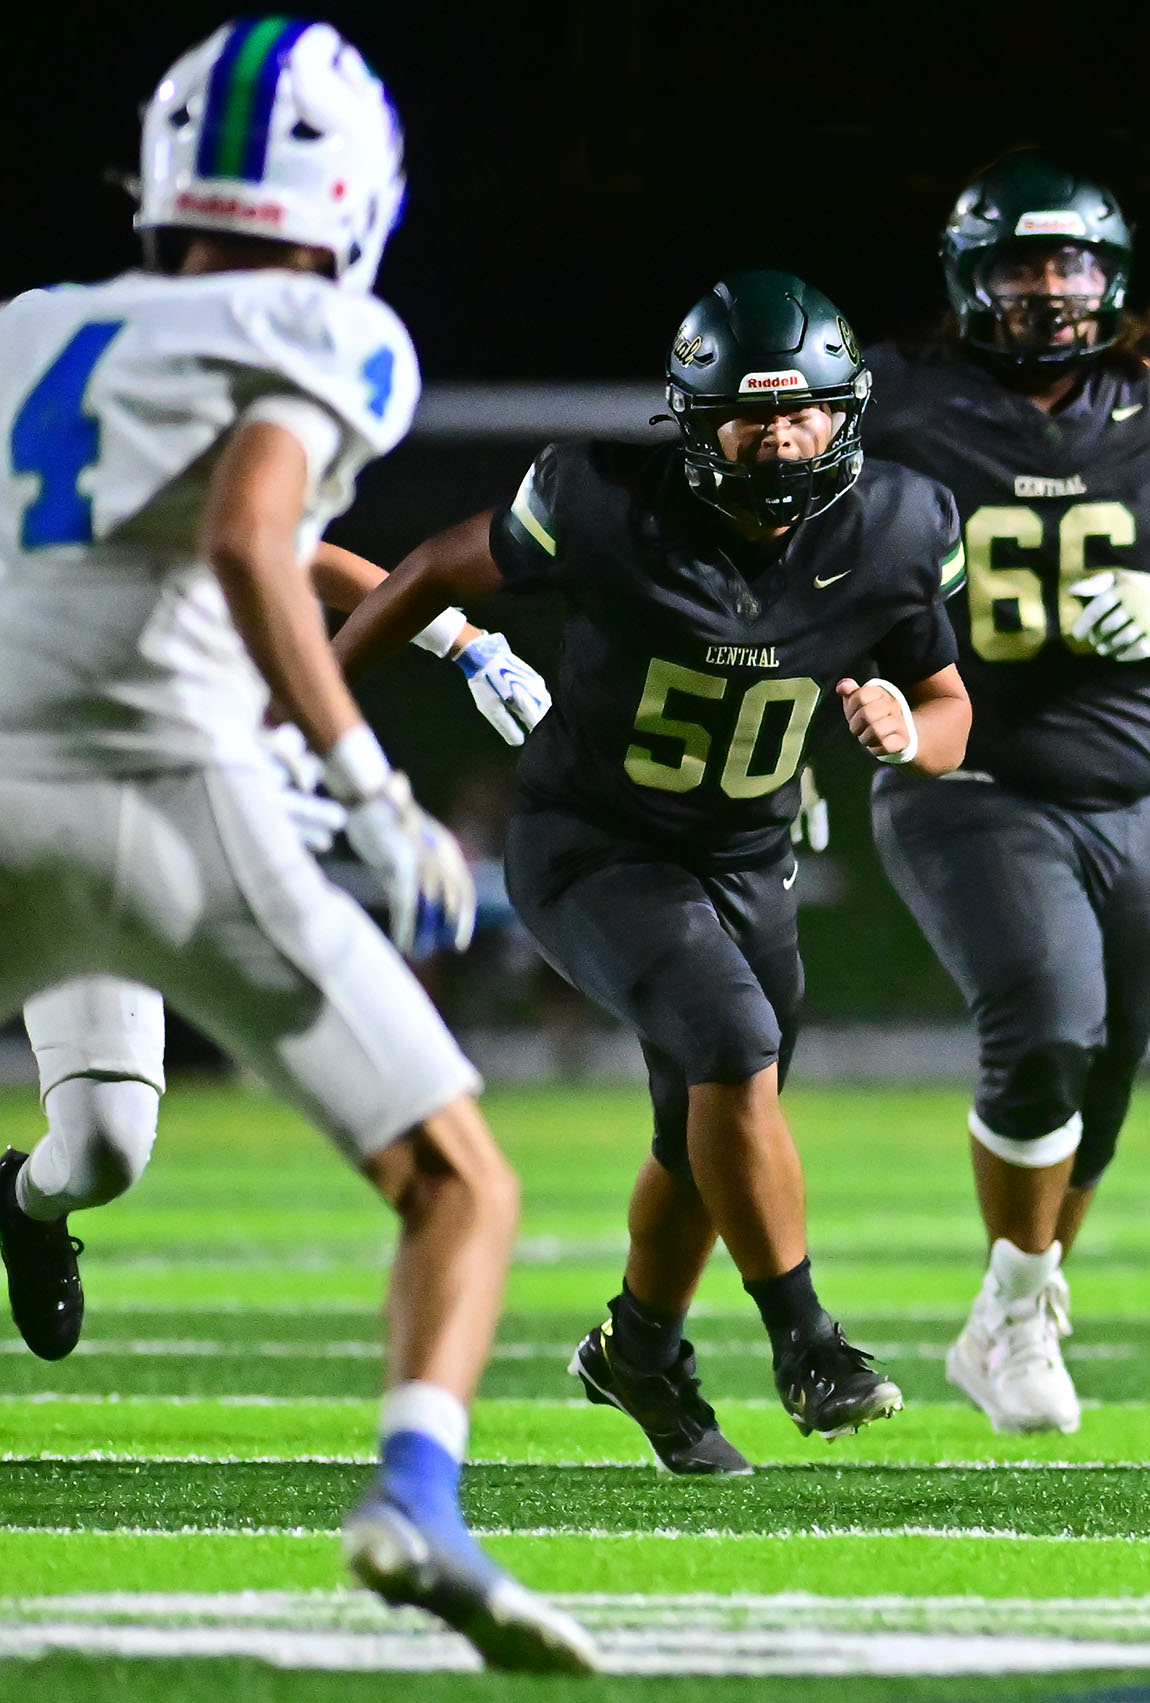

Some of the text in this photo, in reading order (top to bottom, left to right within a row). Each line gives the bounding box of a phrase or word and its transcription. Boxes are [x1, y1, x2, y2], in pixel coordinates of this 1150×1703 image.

[9, 320, 127, 554] 4
[747, 376, 799, 389] Riddell
[965, 502, 1137, 662] 66
[624, 657, 821, 799] 50
[705, 646, 780, 668] CENTRAL
